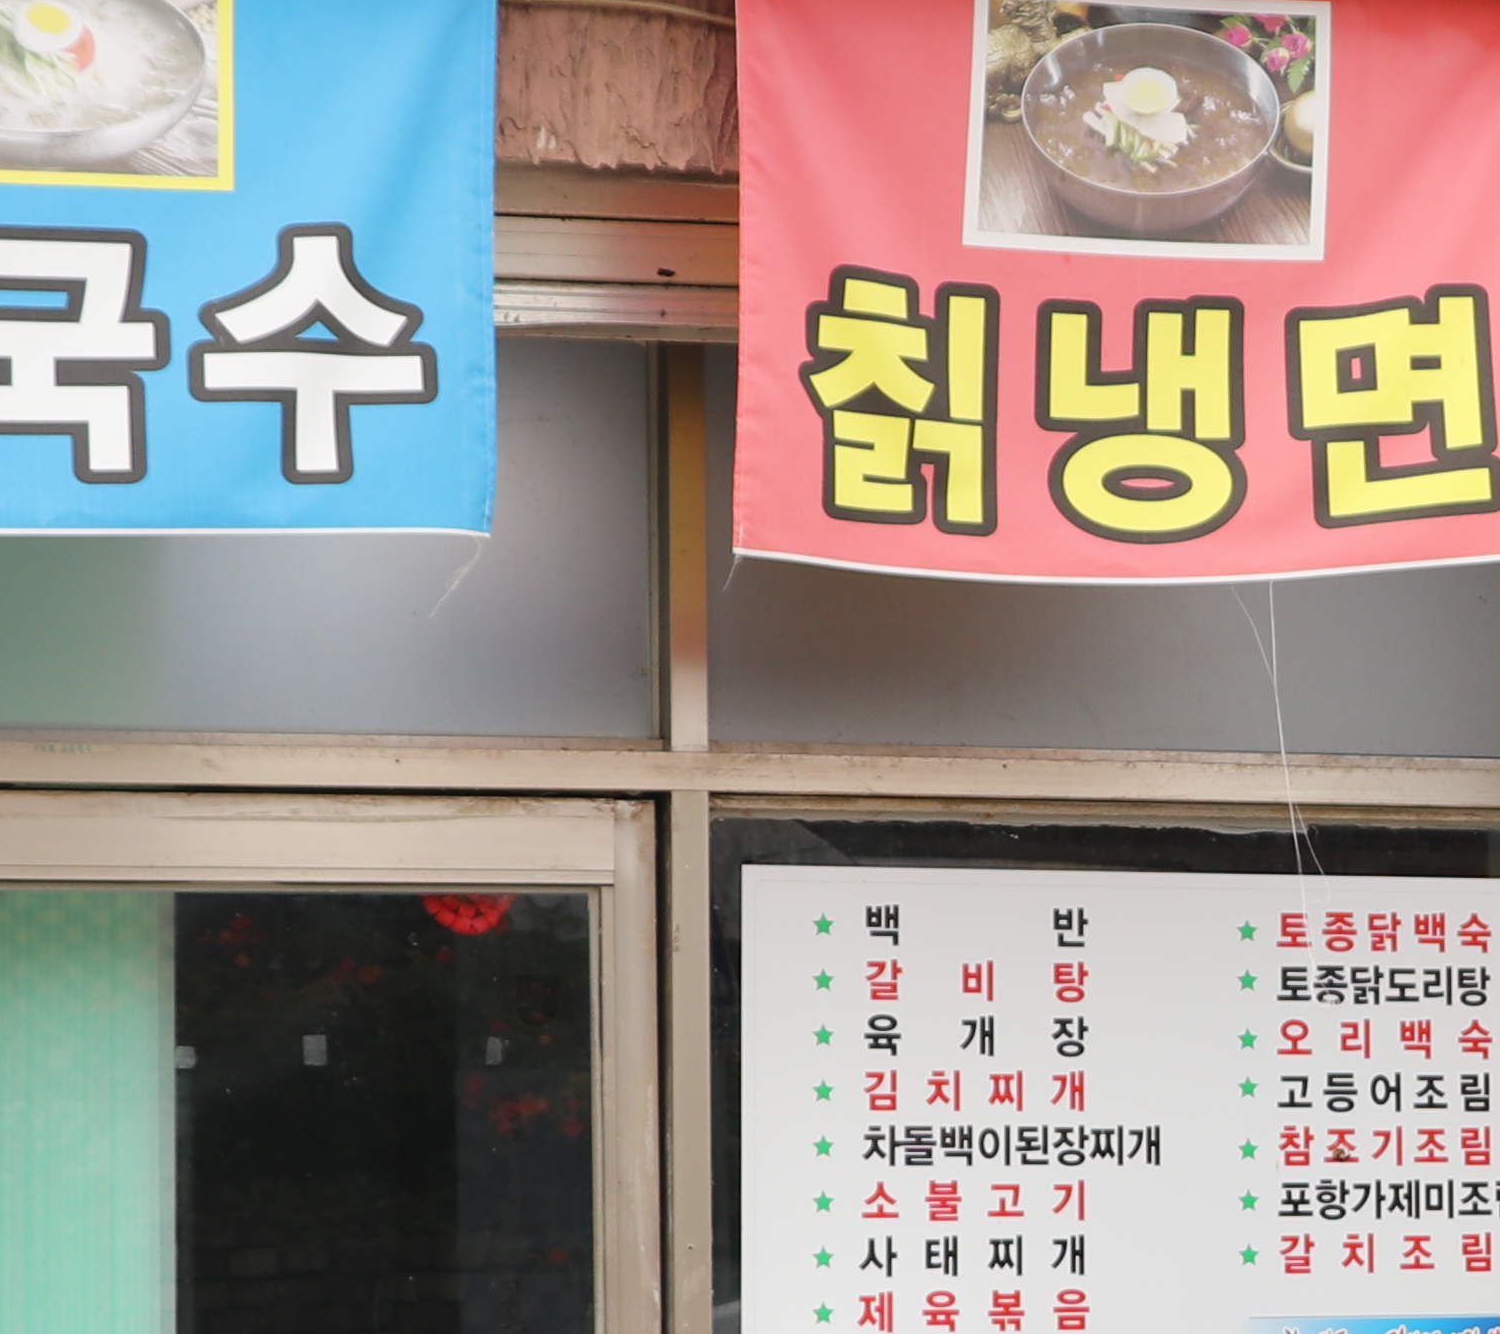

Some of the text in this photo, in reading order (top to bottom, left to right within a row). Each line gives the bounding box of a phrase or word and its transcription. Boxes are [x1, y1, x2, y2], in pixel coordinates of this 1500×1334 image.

[1276, 912, 1492, 954] 토종닭백숙
[1276, 965, 1491, 1007] 토종닭도리탕
[1277, 1019, 1493, 1060] 오리백숙
[865, 1070, 1086, 1112] 김치찌개
[1277, 1072, 1491, 1113] 고등어조림
[863, 1125, 1161, 1167] 차돌백이된장찌개
[1278, 1125, 1491, 1167] 참조기조림
[862, 1180, 1086, 1221] 소불고기
[860, 1235, 1086, 1277] 사태찌개
[1279, 1232, 1492, 1274] 갈치조림
[858, 1290, 1089, 1332] 제육볶음
